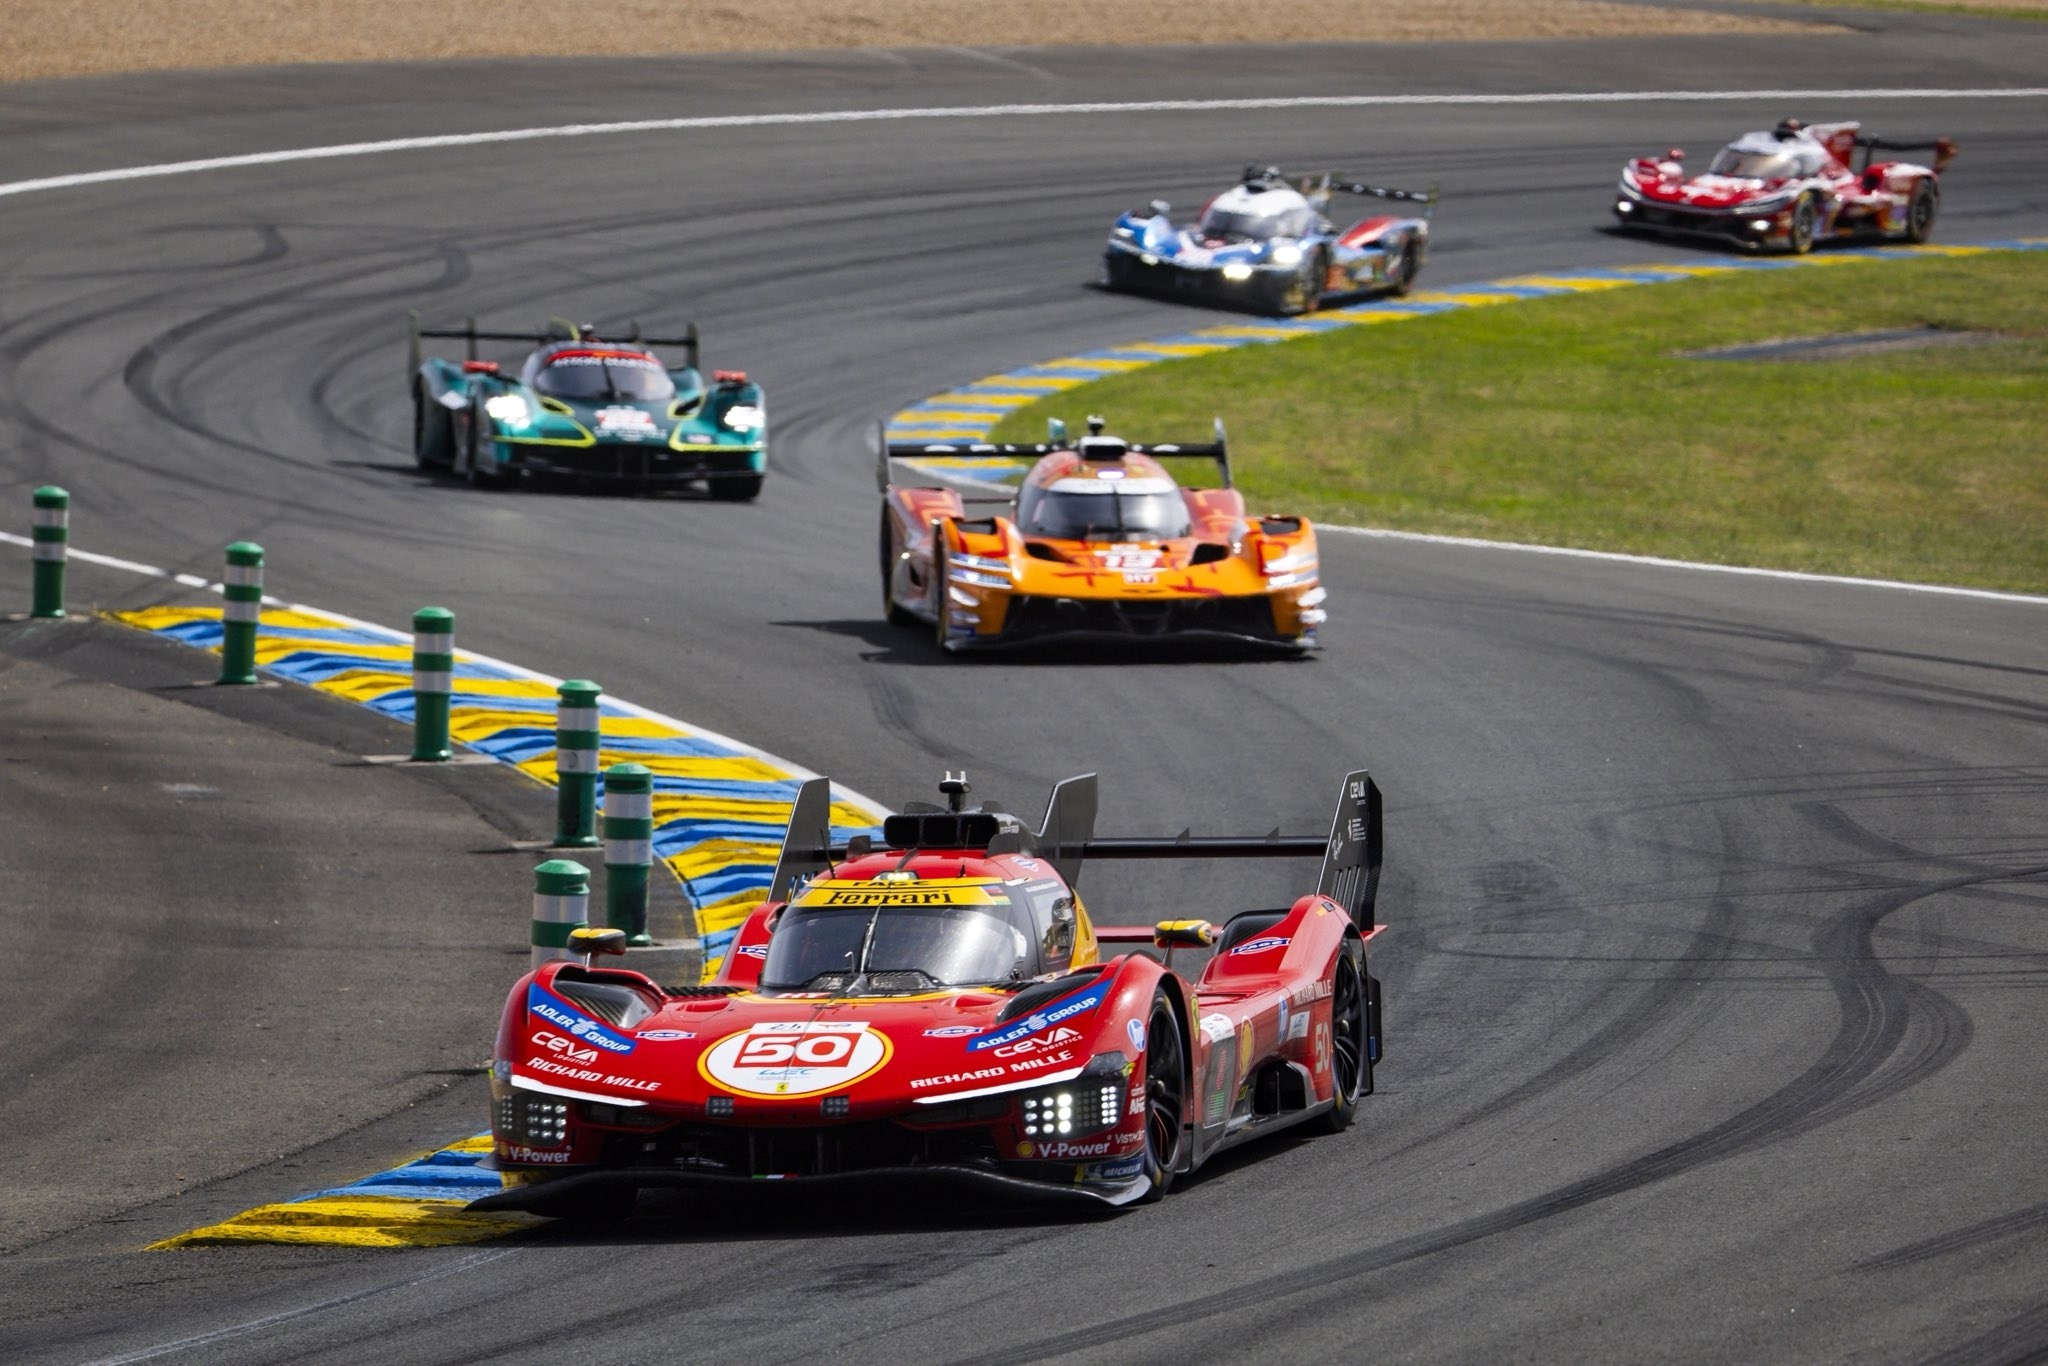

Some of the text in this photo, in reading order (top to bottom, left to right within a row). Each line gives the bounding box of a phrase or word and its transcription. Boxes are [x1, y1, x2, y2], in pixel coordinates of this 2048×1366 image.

[823, 888, 954, 905] Ferrari
[531, 1003, 632, 1052] ADLER GROUP
[976, 997, 1097, 1049] ADLER GROUP
[739, 1035, 852, 1064] 50
[1036, 1035, 1084, 1054] LOGISTICS
[1316, 1022, 1330, 1073] 50
[526, 1057, 662, 1091] RICHARD MILLE
[909, 1049, 1074, 1089] RICHARD MILLE
[509, 1146, 571, 1163] V-Power
[1038, 1142, 1111, 1158] V-Power
[1103, 1163, 1143, 1177] MICHELIN
